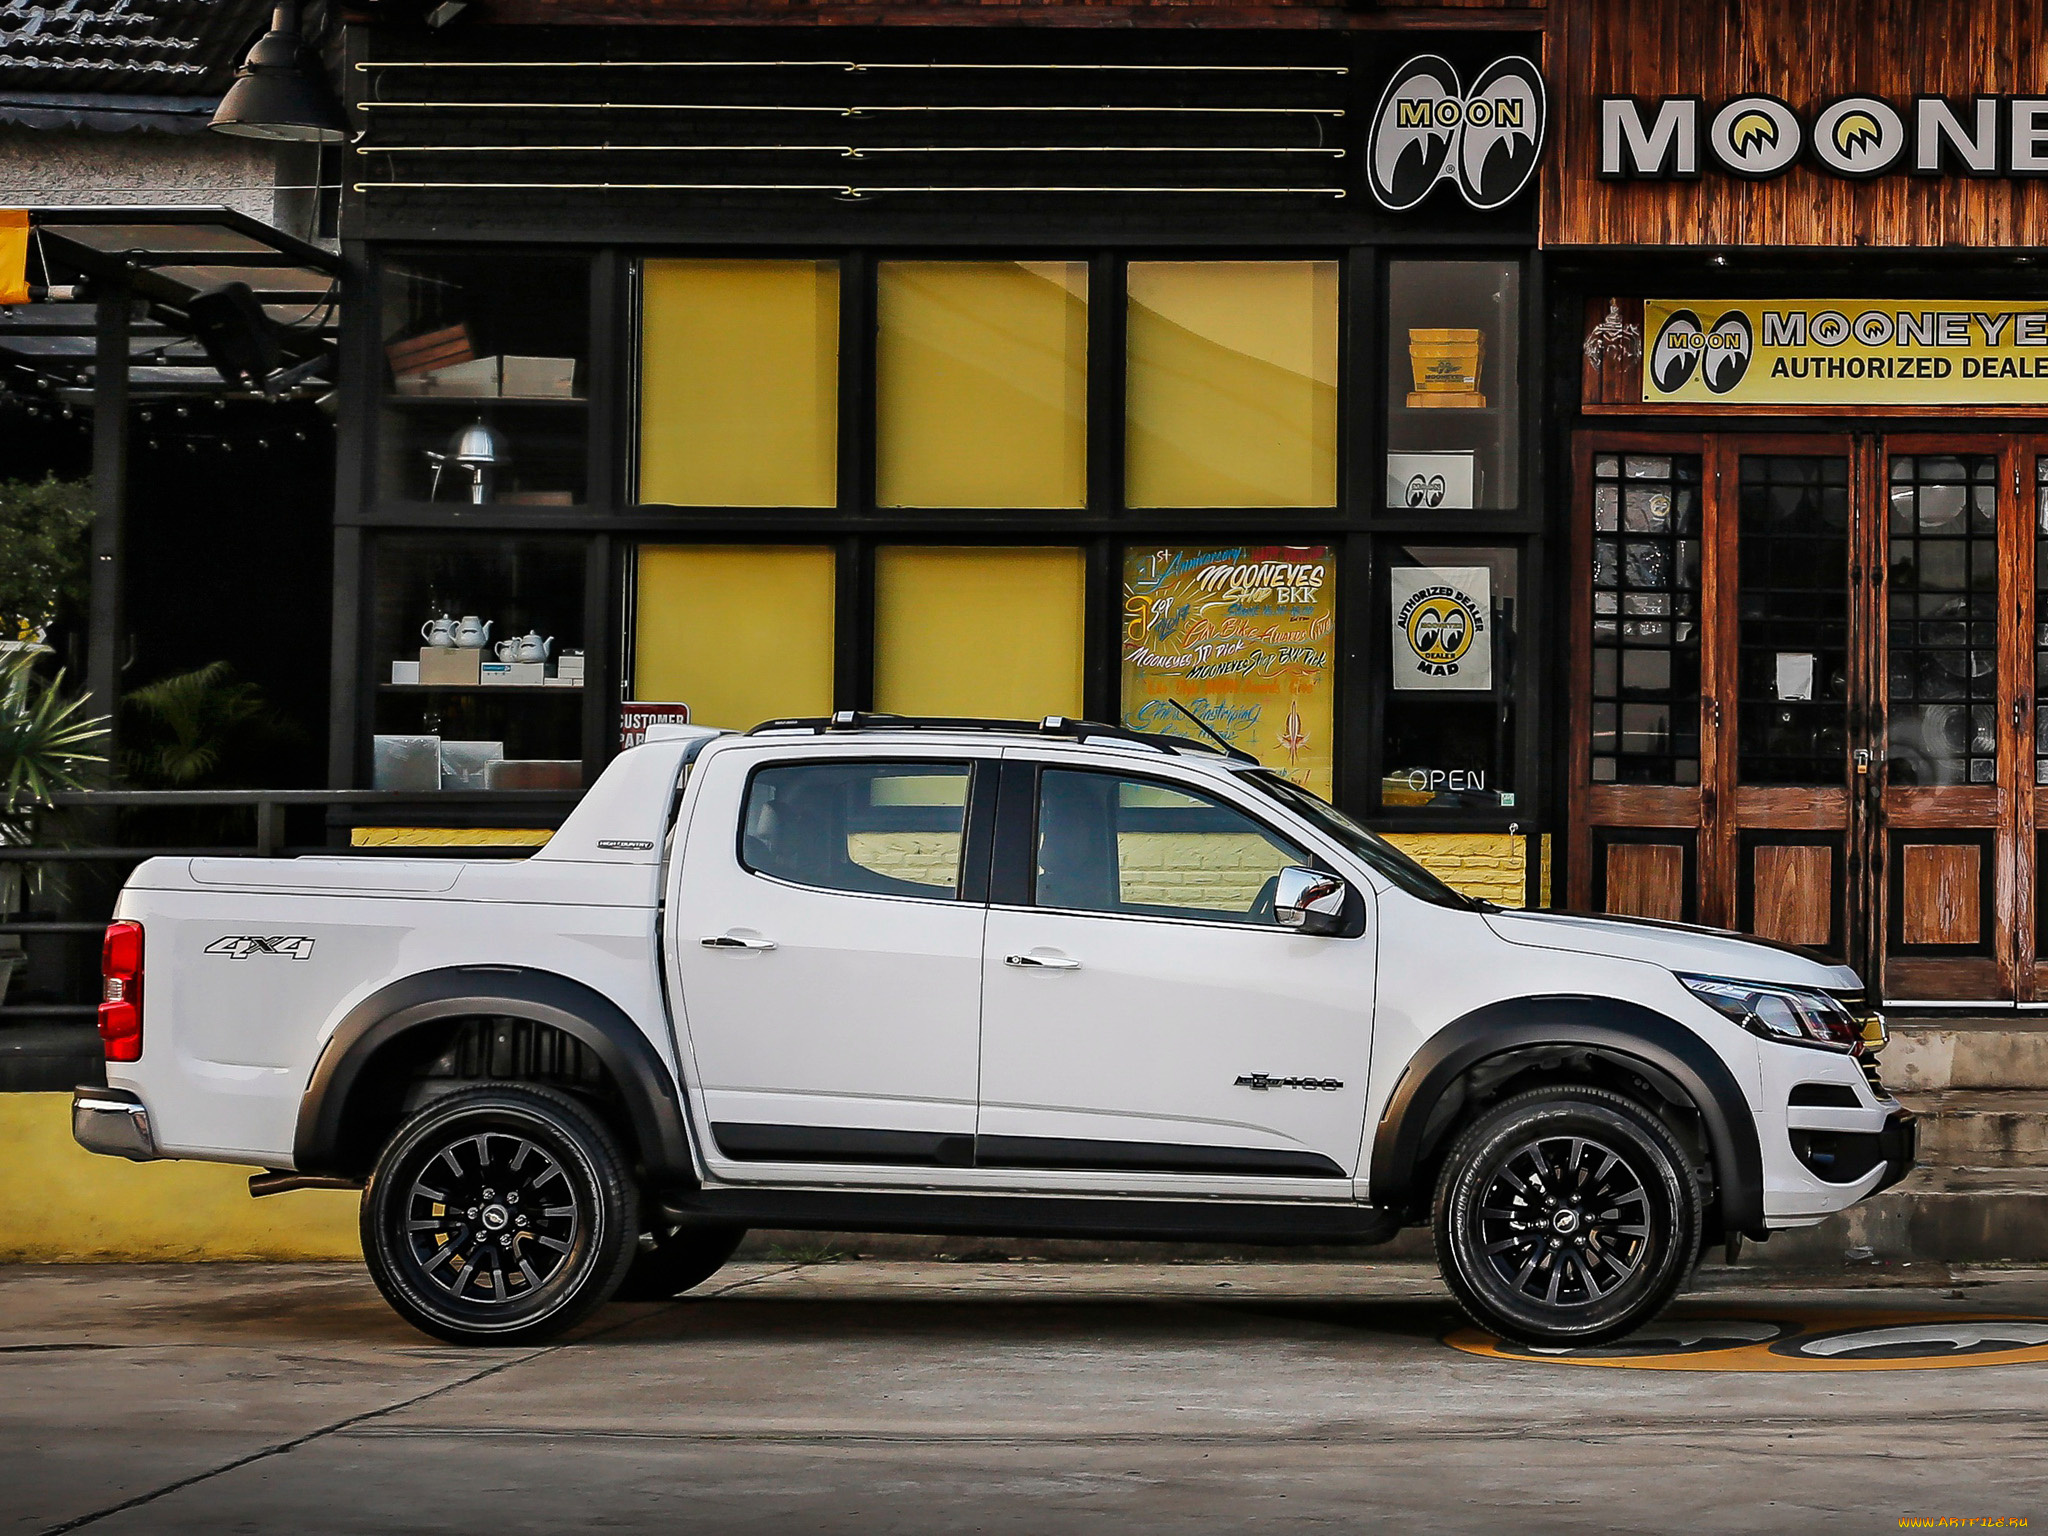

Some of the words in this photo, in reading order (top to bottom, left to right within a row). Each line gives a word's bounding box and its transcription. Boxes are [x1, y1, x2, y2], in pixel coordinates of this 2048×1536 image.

[1397, 97, 1523, 128] MOON
[1601, 97, 2048, 176] MOONE
[1667, 332, 1741, 350] MOON
[1762, 310, 2048, 348] MOONEYE
[1771, 356, 1952, 379] AUTHORIZED
[1962, 356, 2048, 379] DEALE
[1196, 563, 1325, 592] MOONEYES
[1277, 586, 1319, 604] BKK
[1397, 586, 1454, 630] AUTHORIZED
[1454, 591, 1484, 633] DEALER
[1416, 660, 1460, 676] MAD
[1408, 770, 1485, 791] OPEN
